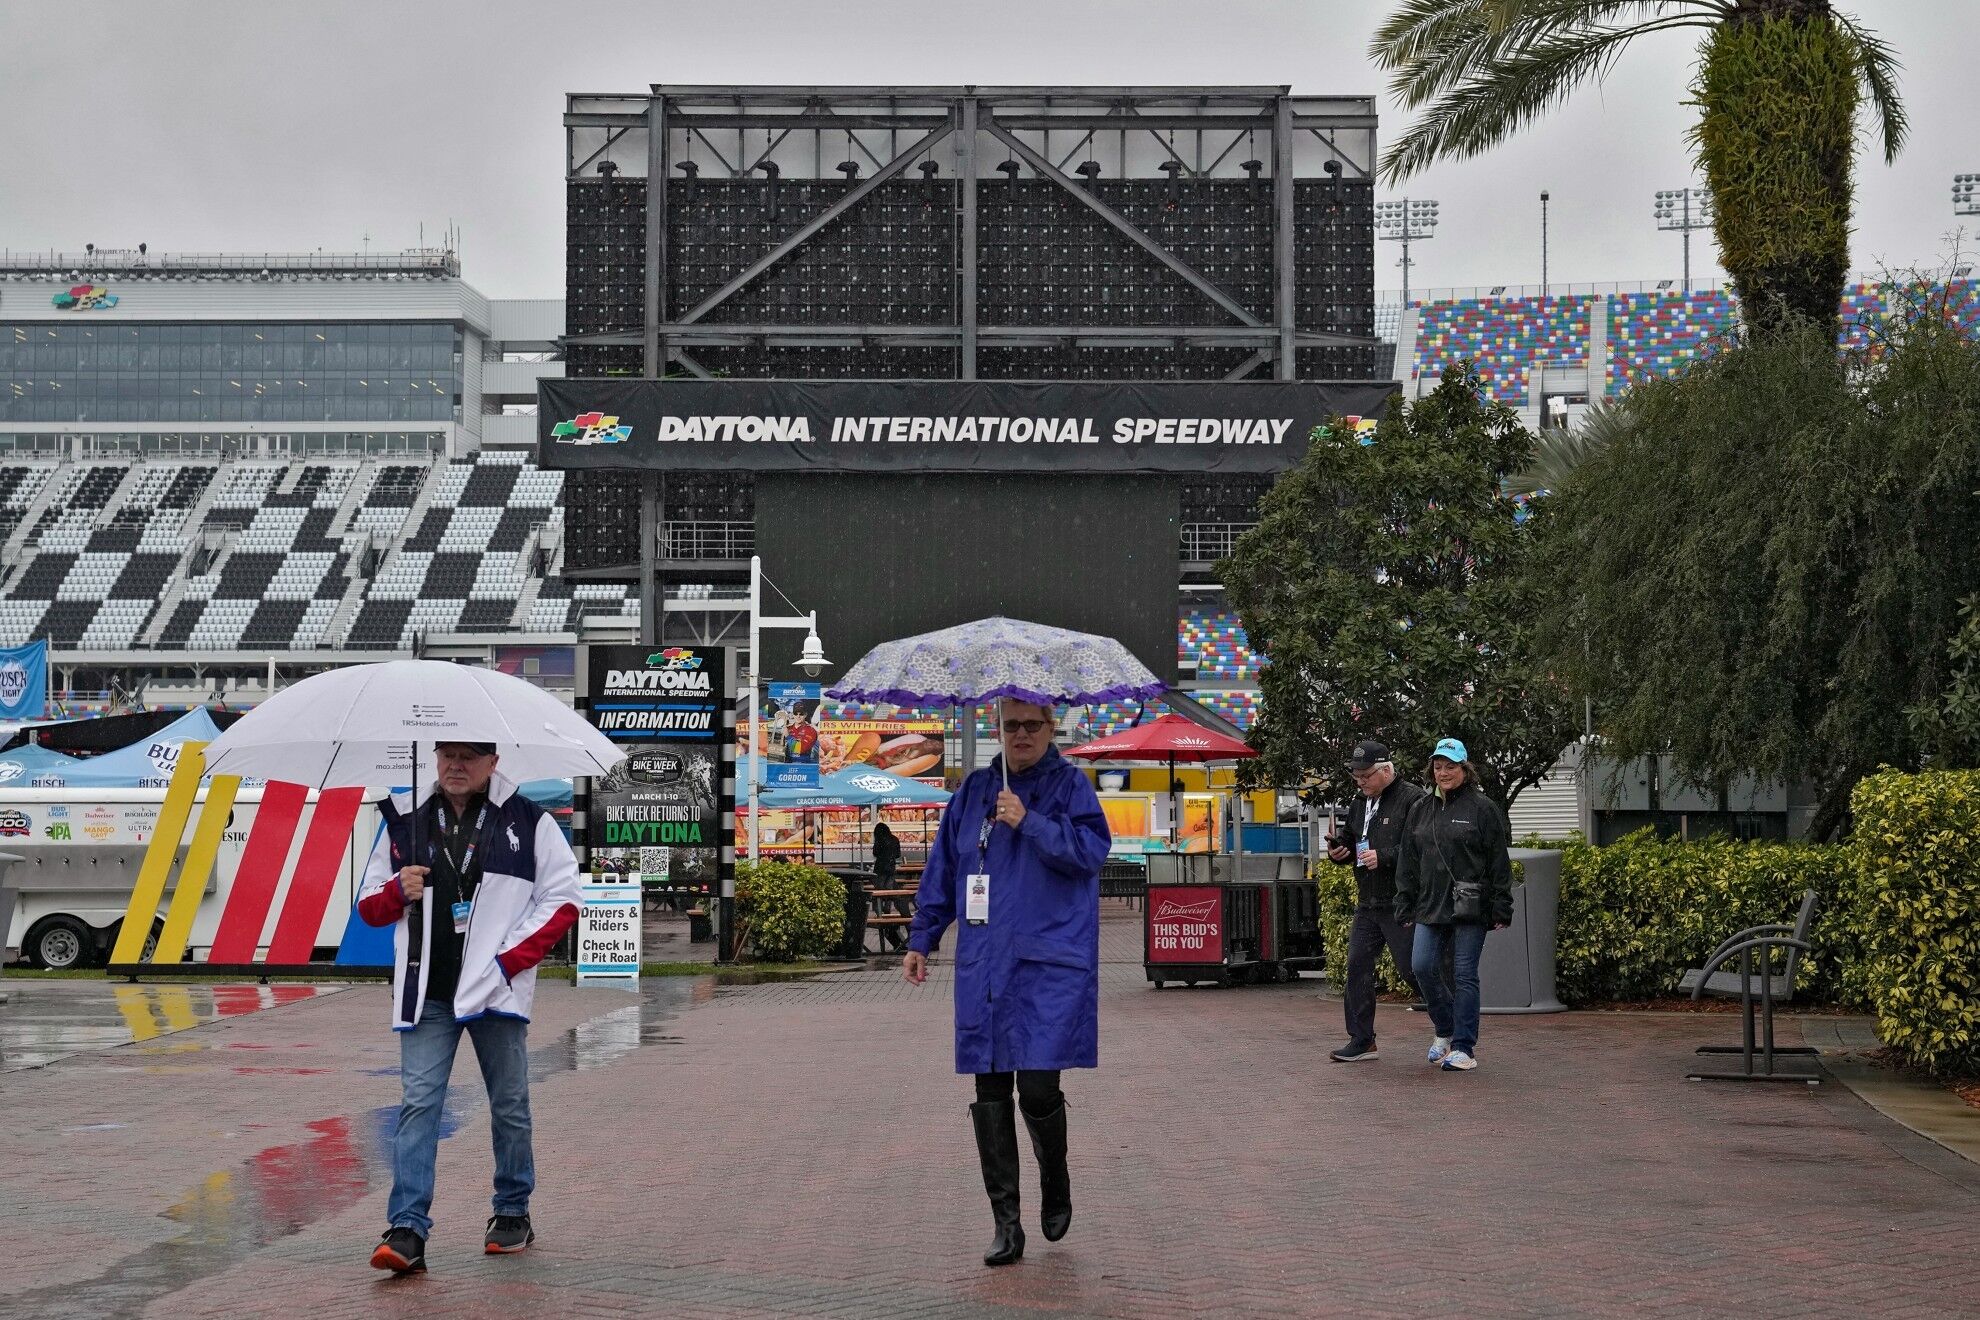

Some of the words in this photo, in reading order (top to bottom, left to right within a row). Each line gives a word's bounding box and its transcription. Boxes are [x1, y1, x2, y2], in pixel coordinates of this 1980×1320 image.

[658, 415, 813, 442] DAYTONA
[831, 416, 1099, 443] INTERNATIONAL
[1112, 417, 1293, 444] SPEEDWAY
[0, 671, 27, 688] USCH
[605, 670, 711, 690] DAYTONA
[599, 712, 711, 729] INFORMATION
[632, 761, 652, 770] BIKE
[653, 761, 677, 770] WEEK
[32, 780, 65, 788] BUSCH
[778, 774, 807, 782] GORDON
[606, 806, 625, 821] BIKE
[626, 806, 648, 821] WEEK
[650, 806, 688, 821] RETURNS
[691, 806, 700, 821] TO
[222, 832, 248, 841] ESTIC
[606, 823, 702, 842] DAYTONA
[581, 906, 624, 918] Drivers
[629, 907, 638, 918] &
[1159, 905, 1209, 915] Budweiser
[590, 920, 629, 931] Riders
[1153, 924, 1179, 935] THIS
[1183, 924, 1218, 936] BUD'S
[583, 940, 620, 951] Check
[624, 940, 635, 951] In
[1155, 937, 1177, 949] FOR
[1180, 937, 1203, 949] YOU
[582, 953, 589, 962] @
[591, 952, 606, 962] Pit
[610, 952, 637, 962] Road
